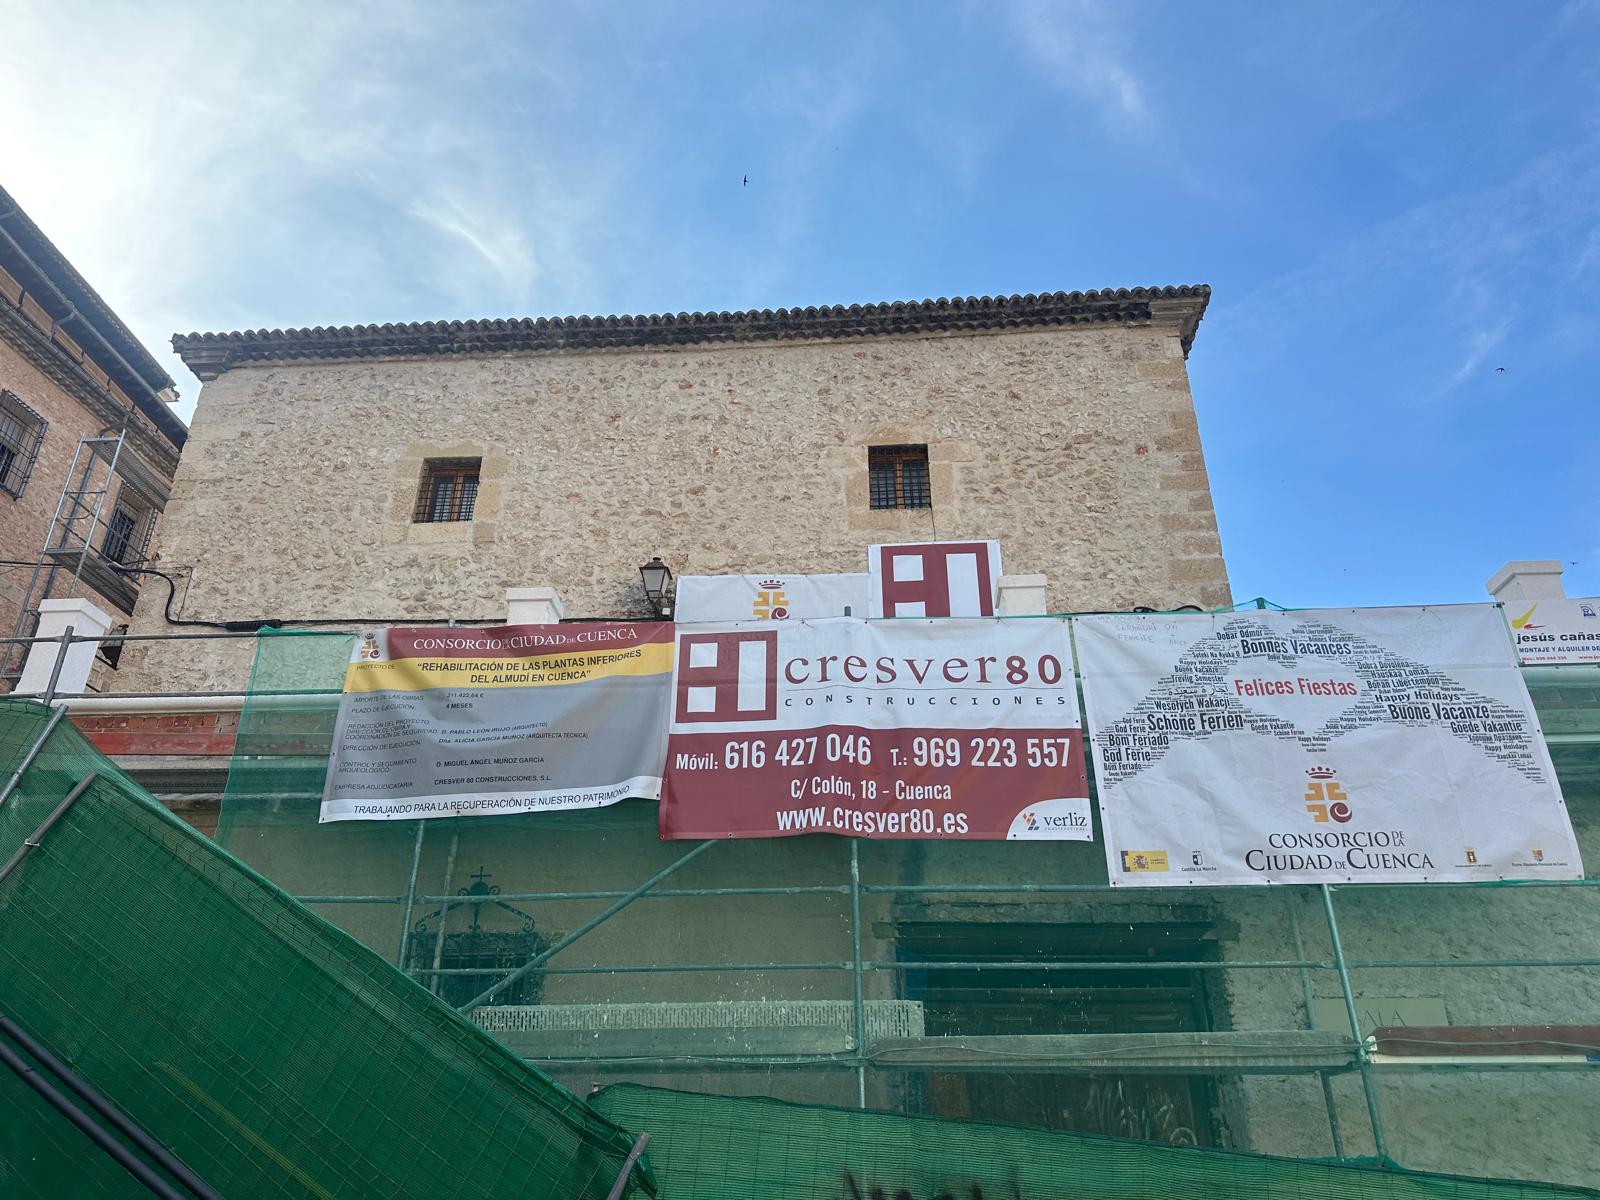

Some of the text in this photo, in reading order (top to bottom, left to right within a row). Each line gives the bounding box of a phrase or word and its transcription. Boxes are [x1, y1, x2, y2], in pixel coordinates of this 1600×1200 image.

[413, 638, 502, 650] CONSORCIO
[511, 634, 566, 649] CIUDAD
[577, 628, 637, 643] CUENCA
[1216, 629, 1263, 641] Dobar Odmor
[1516, 631, 1600, 646] jesús cañas
[1240, 639, 1288, 656] Bonnes
[1289, 640, 1352, 656] Vacances
[1519, 646, 1550, 654] MONTAJE
[506, 662, 519, 671] DE
[522, 661, 541, 671] LAS
[543, 657, 584, 670] PLANTAS
[587, 649, 642, 667] INFERIORES
[1198, 658, 1223, 666] Holidays
[784, 653, 1063, 686] cresver80
[1194, 666, 1219, 674] Vacanze
[1404, 668, 1430, 677] Lomaa
[470, 675, 490, 683] DEL
[492, 672, 529, 683] ALMUDÍ
[532, 674, 544, 682] EN
[1171, 674, 1224, 684] Trevlig Semester
[1234, 679, 1295, 698] Felices
[1296, 677, 1358, 698] Fiestas
[784, 694, 1066, 707] CONSTRUCCIONES
[1374, 694, 1411, 704] Happy
[1414, 691, 1461, 702] Holidays
[1154, 696, 1231, 713] Wesołych Wakacji
[1388, 704, 1431, 721] Buone
[1432, 702, 1490, 721] Vacanze
[512, 721, 548, 730] (ARQUITECTO)
[1147, 711, 1244, 733] Schöne Ferien
[1270, 722, 1296, 731] Vakantie
[1450, 720, 1480, 734] Goede
[1480, 720, 1523, 734] Vakantie
[1114, 724, 1146, 734] God Ferie
[526, 732, 562, 740] (ARQUITECTA
[1108, 734, 1130, 748] Bom
[1132, 732, 1170, 748] Feriado
[1298, 736, 1312, 744] Happy
[342, 744, 378, 752] DIRECCIÓN
[675, 733, 872, 771] Móvil: 616 427 046
[891, 749, 908, 766] T.:
[912, 735, 958, 768] 969
[970, 736, 1018, 768] 223
[1027, 737, 1070, 768] 557
[1484, 744, 1529, 754] Happy Holidays
[494, 756, 518, 765] MUÑOZ
[518, 756, 545, 764] GARCÍA
[1102, 747, 1152, 764] God Ferie
[377, 758, 417, 768] SEGUIMIENTO
[1104, 762, 1143, 772] Bom Feriado
[366, 782, 414, 790] ADJUDICATARIA
[434, 778, 465, 786] CRESVER
[790, 777, 808, 800] C/
[811, 775, 856, 800] Colón,
[859, 779, 876, 800] 18
[895, 780, 952, 801] Cuenca
[354, 785, 630, 815] TRABAJANDO PARA LA RECUPERACIÓN DE NUESTRO PATRIMONIO
[776, 805, 969, 835] www.cresver80.es
[1044, 811, 1087, 827] verliz
[1268, 831, 1405, 850] CONSORCIO DE
[1391, 839, 1405, 848] LA
[1244, 847, 1435, 872] CIUDAD DE CUENCA
[1358, 1008, 1407, 1027] ALA
